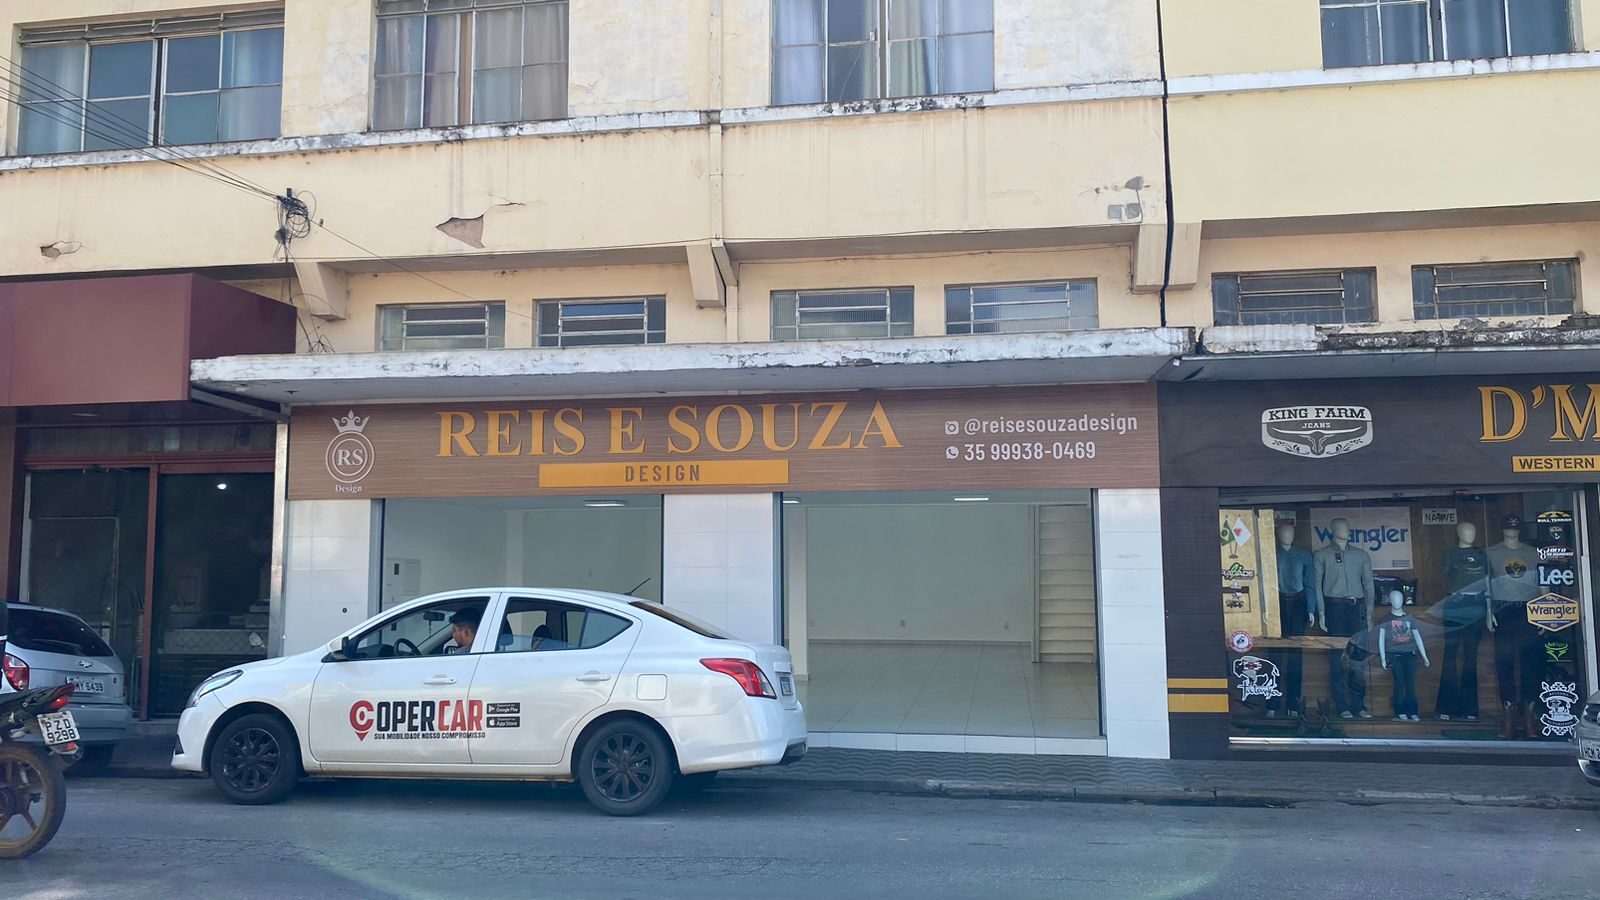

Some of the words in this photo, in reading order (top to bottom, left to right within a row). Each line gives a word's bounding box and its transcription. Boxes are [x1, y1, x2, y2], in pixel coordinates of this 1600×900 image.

[1268, 408, 1308, 420] KING
[1315, 407, 1366, 419] FARM
[434, 406, 586, 457] REIS
[606, 406, 646, 455] E
[667, 399, 904, 455] SOUZA
[964, 412, 1138, 436] @reisesouzadesign
[337, 448, 364, 466] RS
[964, 444, 985, 461] 35
[990, 441, 1096, 461] 99938-0469
[1518, 457, 1595, 470] WESTERN
[624, 464, 701, 482] DESIGN
[335, 484, 363, 494] Design
[1314, 525, 1409, 552] Wangler
[1538, 565, 1574, 586] Lee
[1527, 604, 1577, 619] Wrangler
[350, 699, 484, 732] COPERCAR
[45, 718, 72, 732] PZD
[47, 728, 77, 743] 9298
[386, 732, 421, 740] MOBILIDADE
[441, 731, 486, 739] COMPROMISSO
